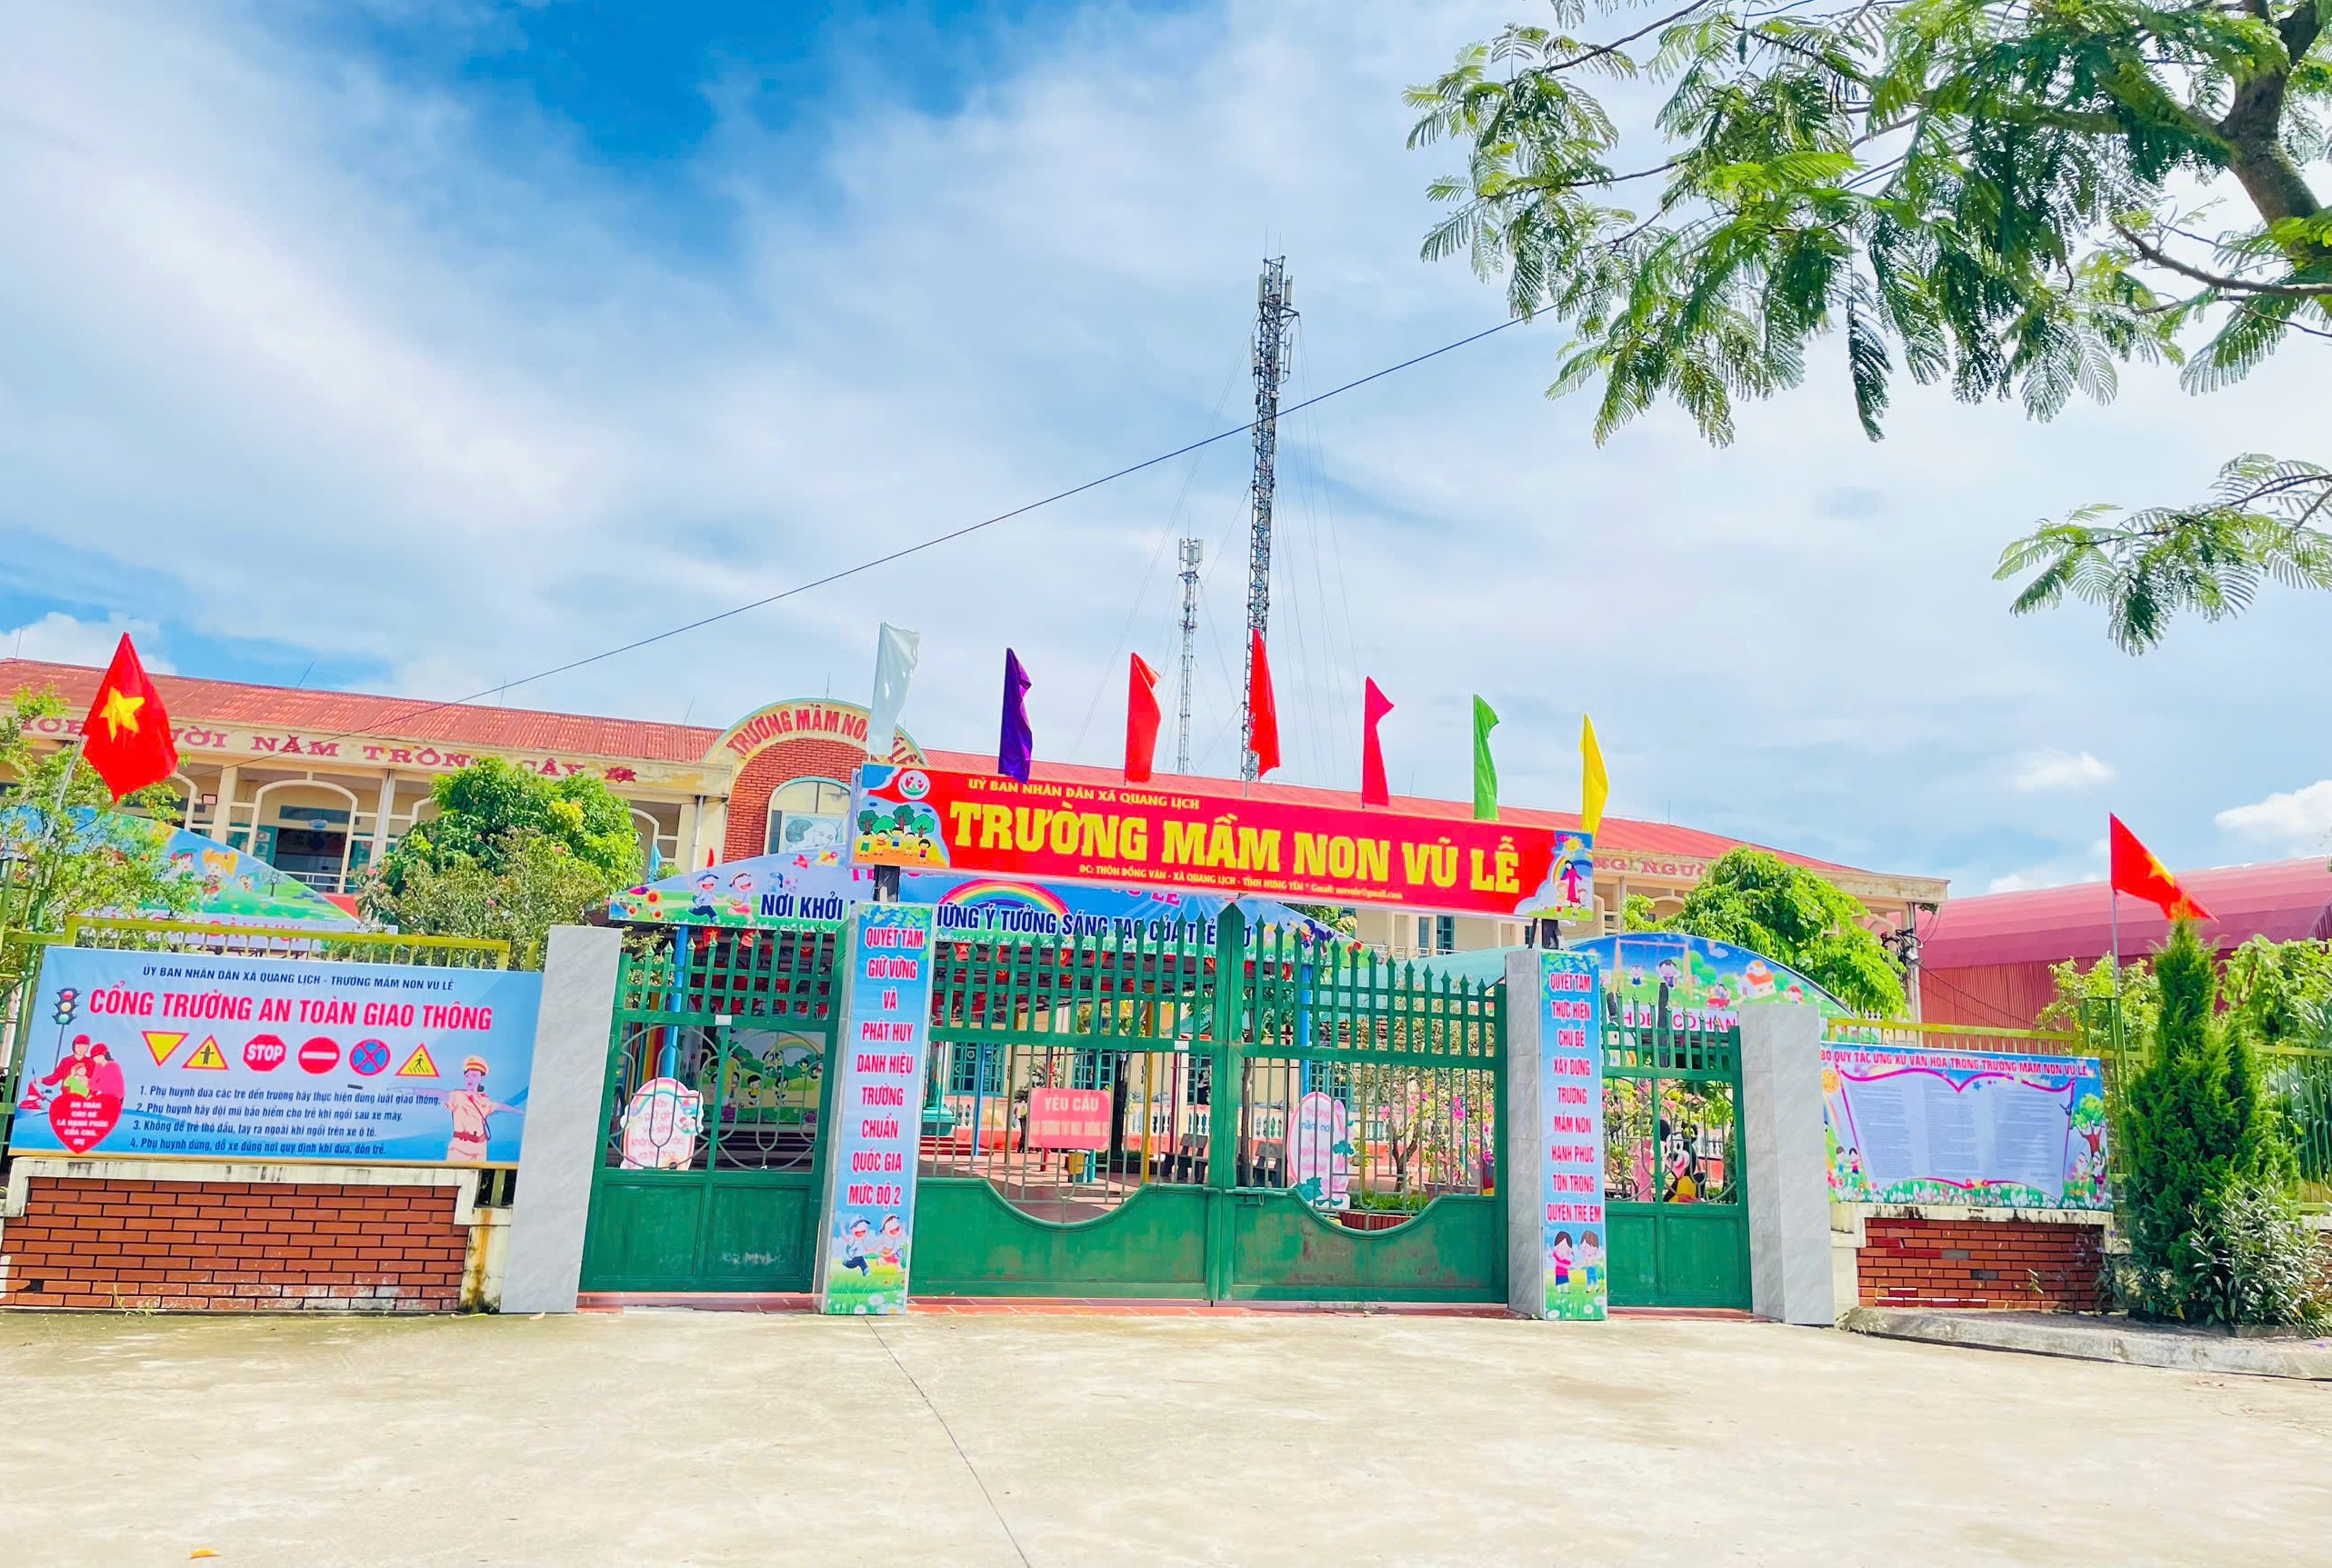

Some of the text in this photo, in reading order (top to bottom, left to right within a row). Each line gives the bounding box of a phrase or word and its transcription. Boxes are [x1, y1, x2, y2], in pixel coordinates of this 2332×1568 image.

[841, 714, 868, 742] NO
[363, 745, 478, 768] TRỒN
[990, 781, 1018, 794] BAN
[1022, 782, 1062, 797] NHÂN
[1066, 784, 1095, 800] DÂN
[1098, 786, 1116, 802] XÃ
[1120, 794, 1167, 807] QUANG
[1172, 796, 1200, 810] LỊCH
[949, 800, 1520, 894] TRƯỜNG MẦM NON VŨ LỄ
[1096, 865, 1119, 874] THÔN
[1122, 864, 1146, 878] ĐỒNG
[1173, 870, 1185, 881] XÃ
[1186, 873, 1216, 883] QUANG
[1218, 875, 1236, 886] LỊCH
[1289, 880, 1304, 891] YÊN
[760, 894, 795, 918] NƠI
[799, 891, 843, 920] KHỞI
[985, 901, 996, 930] Ý
[1001, 904, 1056, 935] TƯỞNG
[1062, 909, 1108, 937] SÁNG
[866, 924, 924, 947] QUYẾT TÂM
[159, 967, 182, 977] BAN
[185, 967, 215, 980] NHÂN
[217, 969, 239, 981] DÂN
[243, 971, 256, 982] XÃ
[260, 973, 295, 984] QUANG
[297, 974, 321, 987] LỊCH
[331, 974, 371, 988] TRƯỜNG
[402, 980, 424, 989] NON
[868, 956, 916, 979] GIỮ VỮNG
[1550, 969, 1591, 992] QUYẾT TÂM
[89, 980, 494, 1031] CỔNG TRƯỜNG AN TOÀN GIAO THÔNG
[884, 988, 896, 1010] VÀ
[1552, 1000, 1590, 1022] THỰC HIỆN
[863, 1019, 913, 1042] PHÁT HUY
[246, 1044, 284, 1062] STOP
[1554, 1054, 1568, 1074] XÂY
[1835, 1051, 1851, 1063] QUY
[1949, 1058, 1979, 1070] TRONG
[2044, 1064, 2062, 1074] NON
[856, 1052, 914, 1078] DANH HIỆU
[169, 1086, 195, 1098] huynh
[395, 1094, 414, 1104] giao
[862, 1083, 904, 1106] TRƯỜNG
[1045, 1094, 1099, 1112] YÊU CẦU
[1557, 1084, 1587, 1104] TRƯỜNG
[165, 1104, 192, 1116] huynh
[286, 1107, 302, 1118] cho
[318, 1108, 332, 1119] khi
[355, 1111, 369, 1120] sau
[372, 1112, 382, 1120] xe
[1554, 1110, 1591, 1134] MẦM NON
[144, 1120, 171, 1133] Không
[238, 1124, 251, 1135] tay
[254, 1126, 263, 1134] ra
[291, 1125, 305, 1134] khi
[346, 1128, 356, 1136] xe
[862, 1113, 898, 1139] CHUẨN
[852, 1147, 903, 1173] QUỐC GIA
[1552, 1144, 1594, 1166] HẠNH PHÚC
[1553, 1171, 1595, 1196] TÔN TRỌNG
[848, 1182, 901, 1210] MỨC ĐỘ 2
[1590, 1206, 1601, 1223] EM
